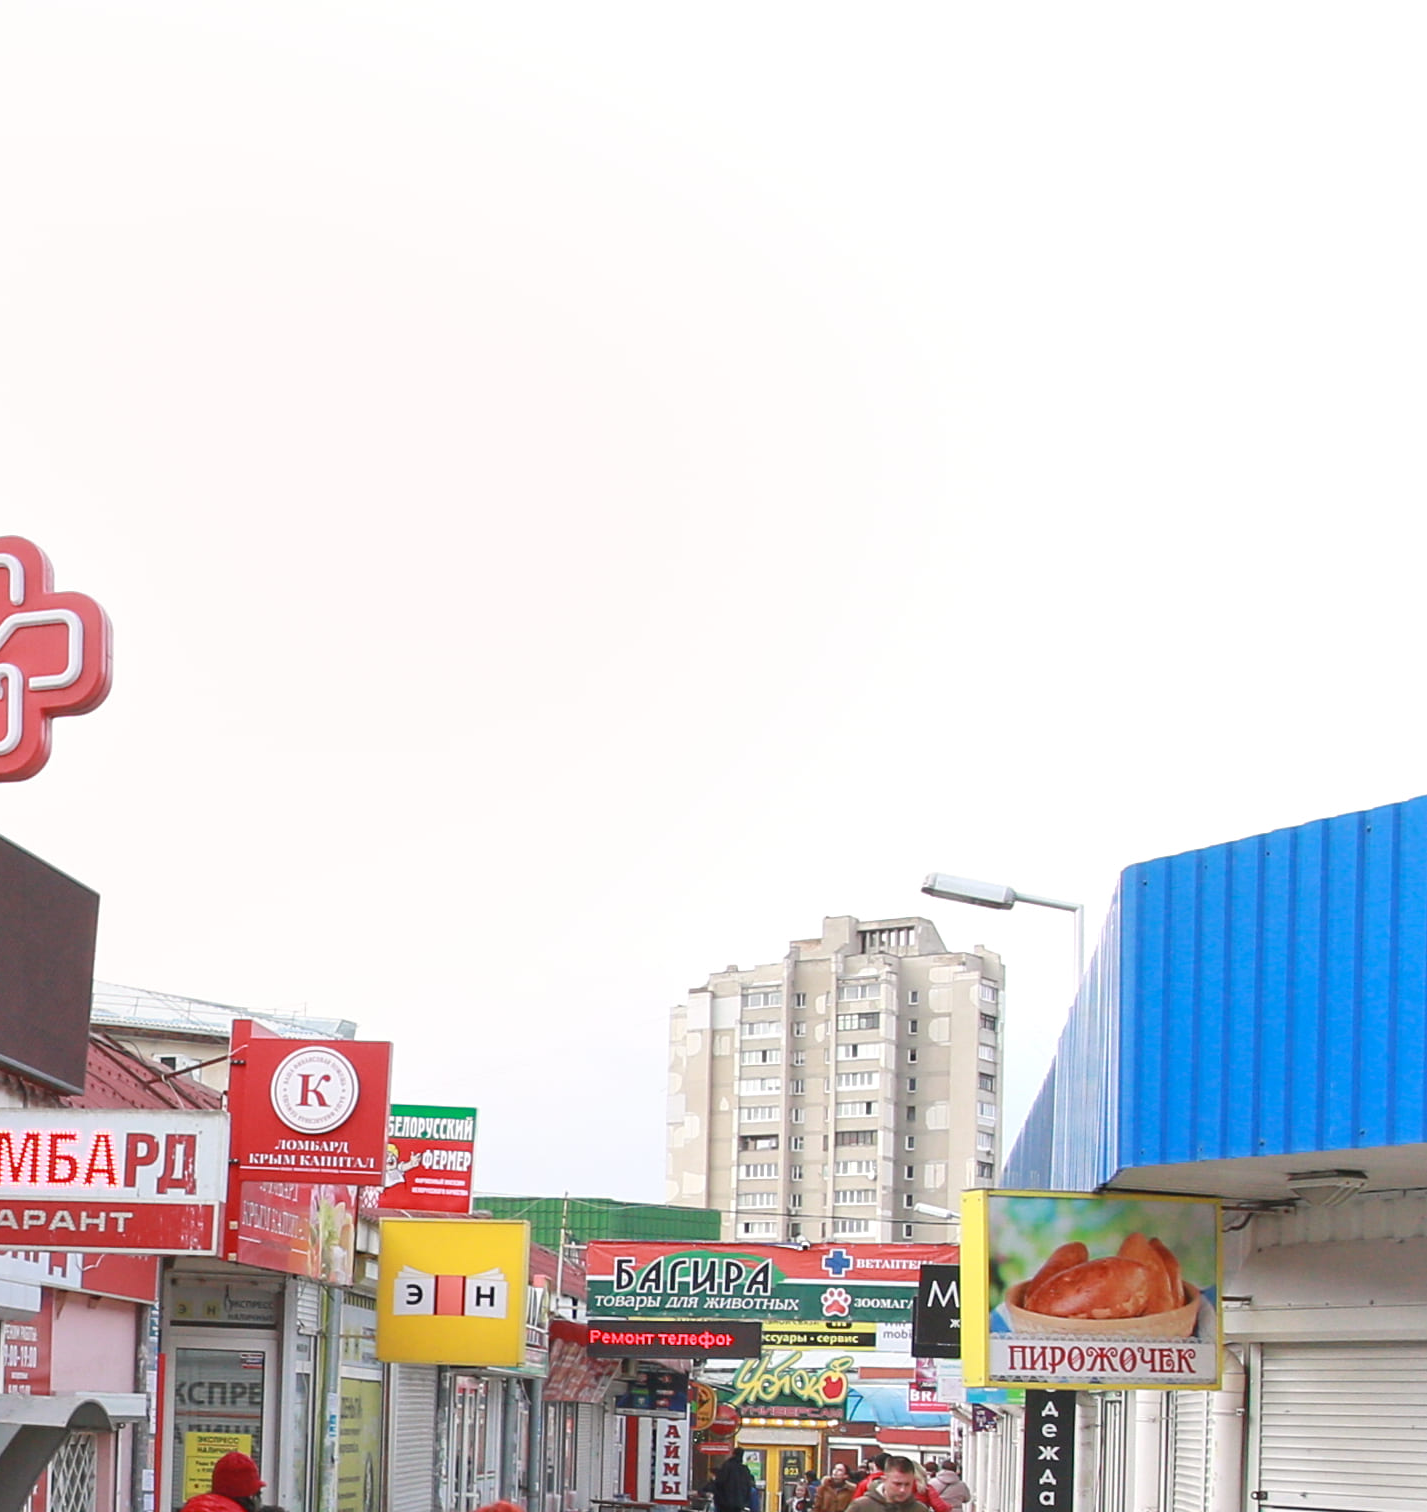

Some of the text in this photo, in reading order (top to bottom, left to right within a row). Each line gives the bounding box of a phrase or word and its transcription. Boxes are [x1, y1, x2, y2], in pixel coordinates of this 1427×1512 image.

[296, 1074, 331, 1107] К
[389, 1115, 474, 1141] БЕЛОРУССКИЙ
[275, 1139, 349, 1154] ЛОМБАРД
[249, 1153, 375, 1169] КРЫМ КАПИТАЛ
[422, 1149, 471, 1172] ФЕРМЕР
[613, 1255, 773, 1296] БАГИРА
[856, 1259, 934, 1270] ВЕТАПТЕ
[404, 1283, 424, 1306] Э
[474, 1285, 495, 1307] Н
[595, 1295, 799, 1311] товары для животных
[589, 1329, 655, 1346] Ремонт
[816, 1334, 859, 1345] сервис
[1008, 1344, 1197, 1374] ПИРОЖОЧЕК
[1038, 1389, 1059, 1506] дежда
[661, 1424, 681, 1495] АЙМЫ
